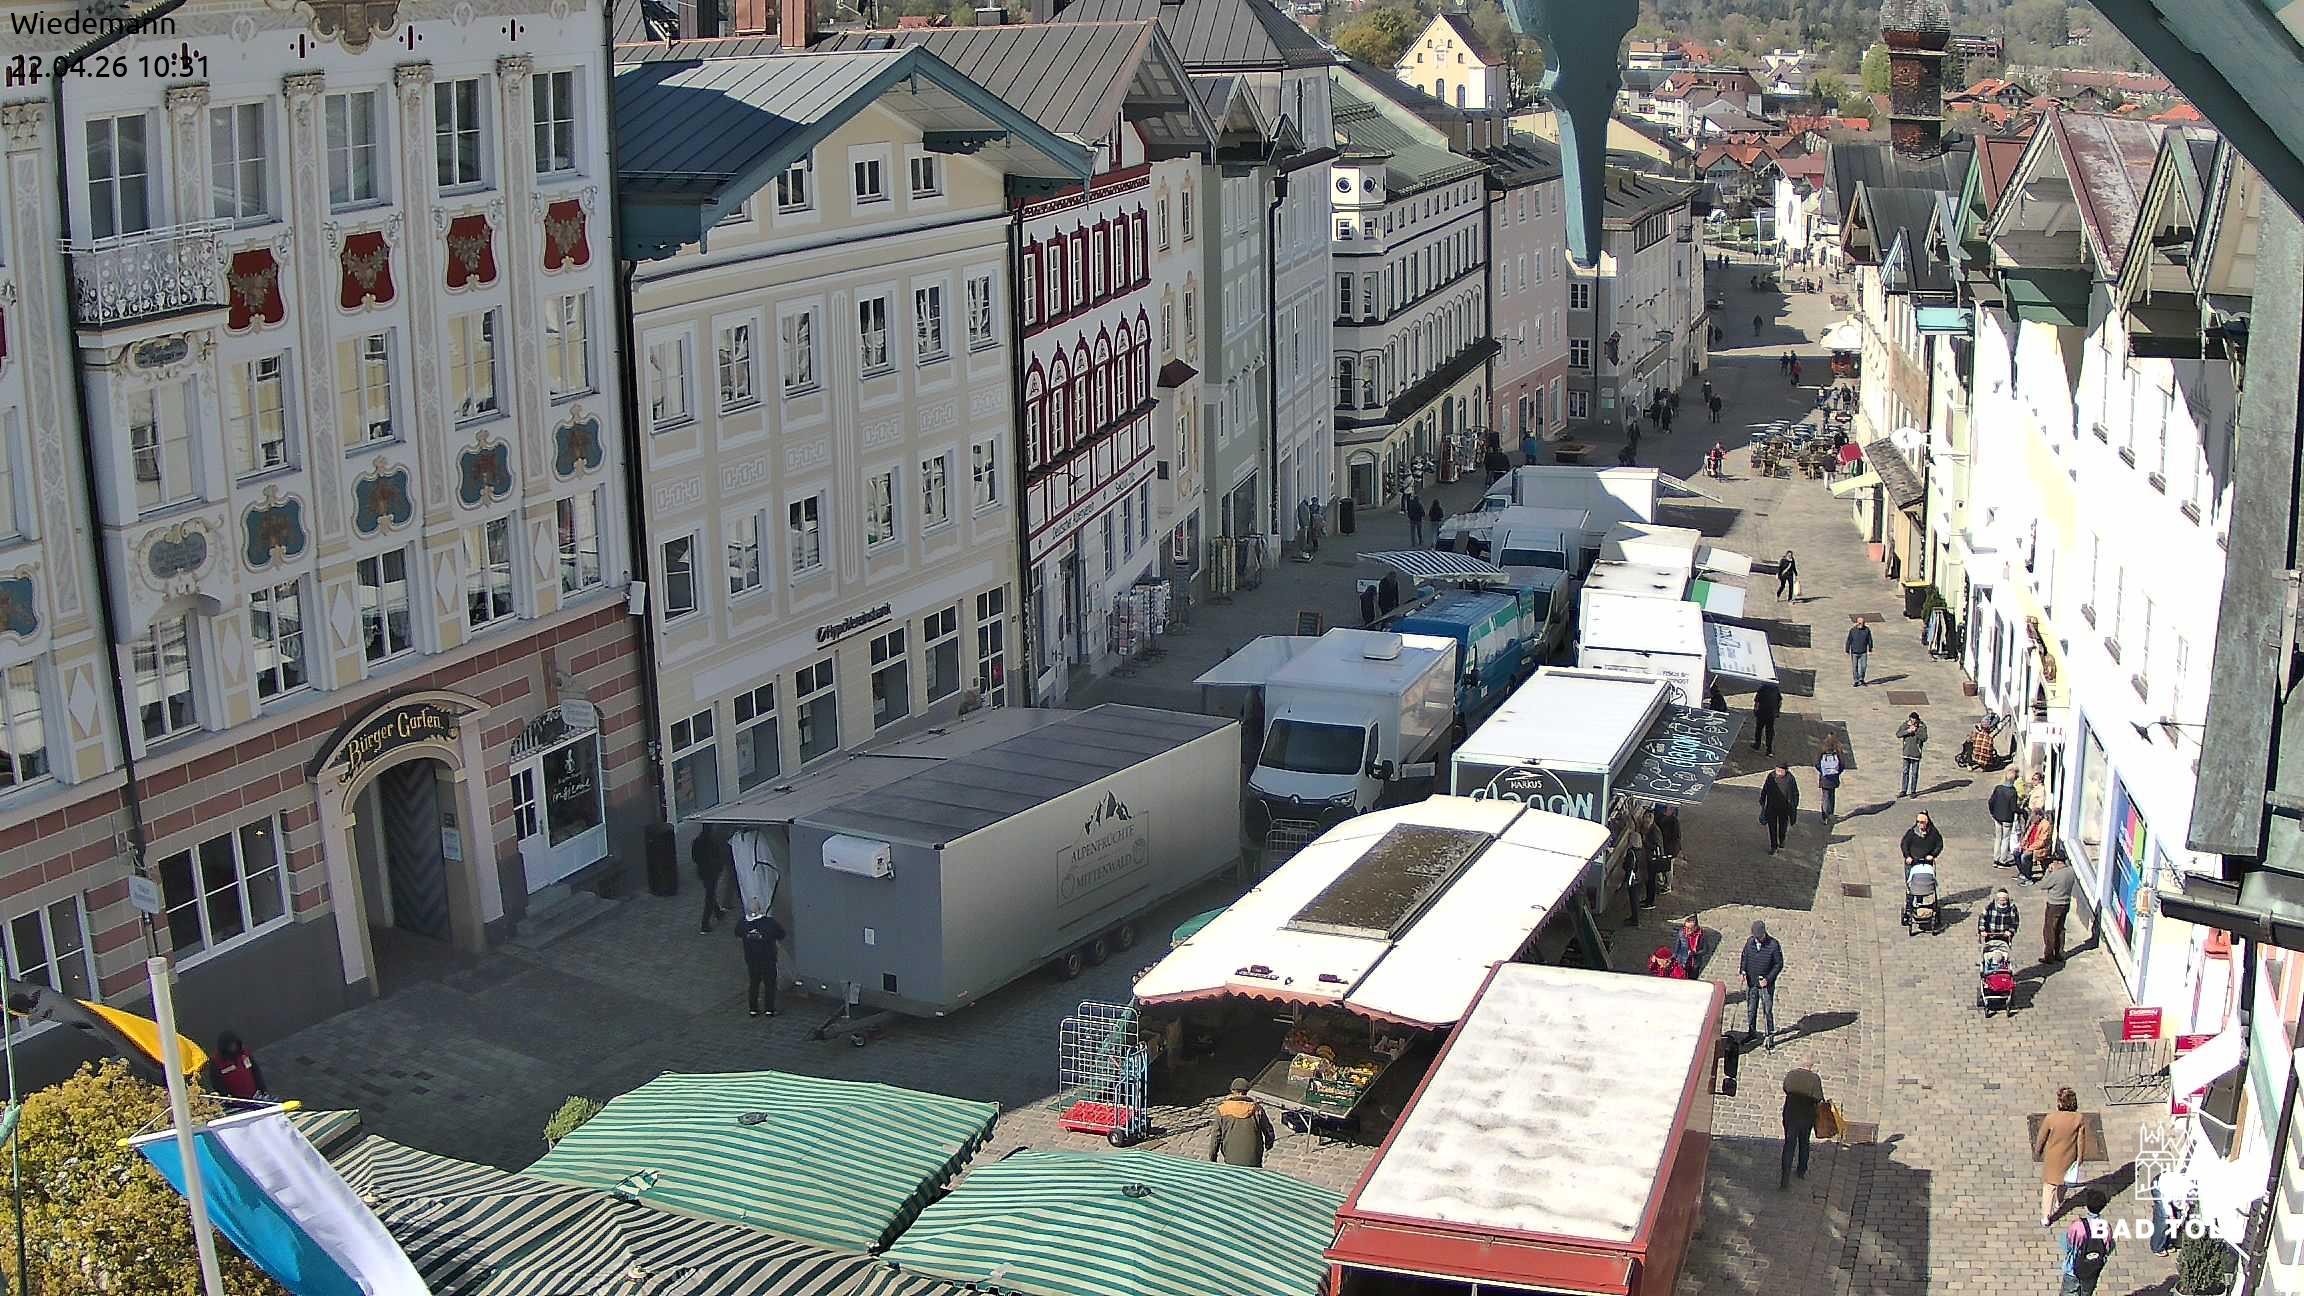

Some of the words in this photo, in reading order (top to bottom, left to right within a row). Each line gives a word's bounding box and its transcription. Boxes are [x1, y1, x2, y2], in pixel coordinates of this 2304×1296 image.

[347, 723, 394, 768] Bürger
[397, 707, 442, 738] Garten
[1076, 854, 1132, 889] MITTENWALD
